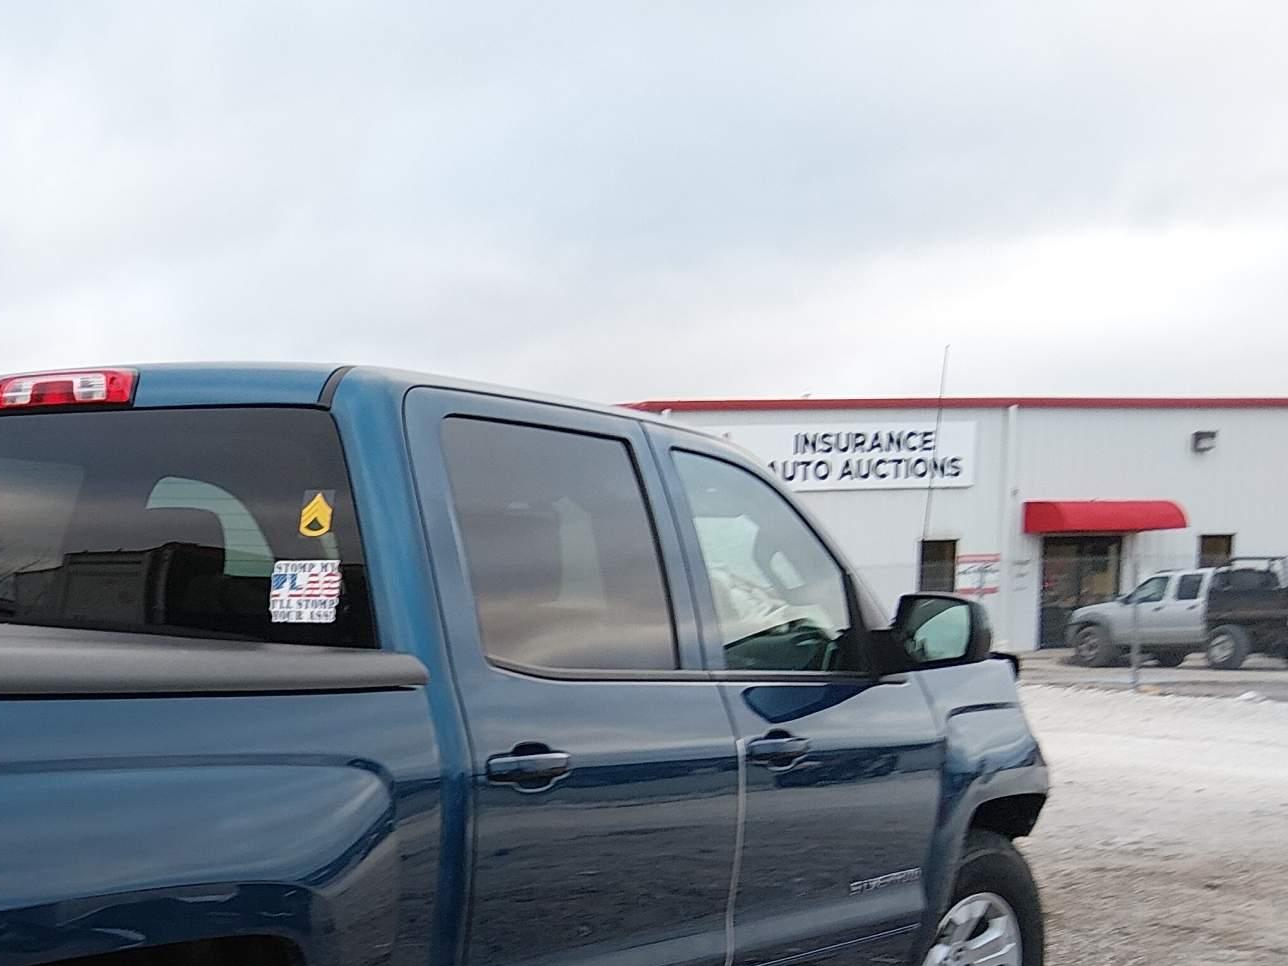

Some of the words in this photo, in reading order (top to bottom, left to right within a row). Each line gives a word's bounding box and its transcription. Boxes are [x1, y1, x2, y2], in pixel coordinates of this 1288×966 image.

[793, 430, 937, 455] INSURANCE
[838, 456, 963, 481] AUCTIONS
[275, 562, 316, 573] STOMP
[295, 599, 337, 610] STOMP
